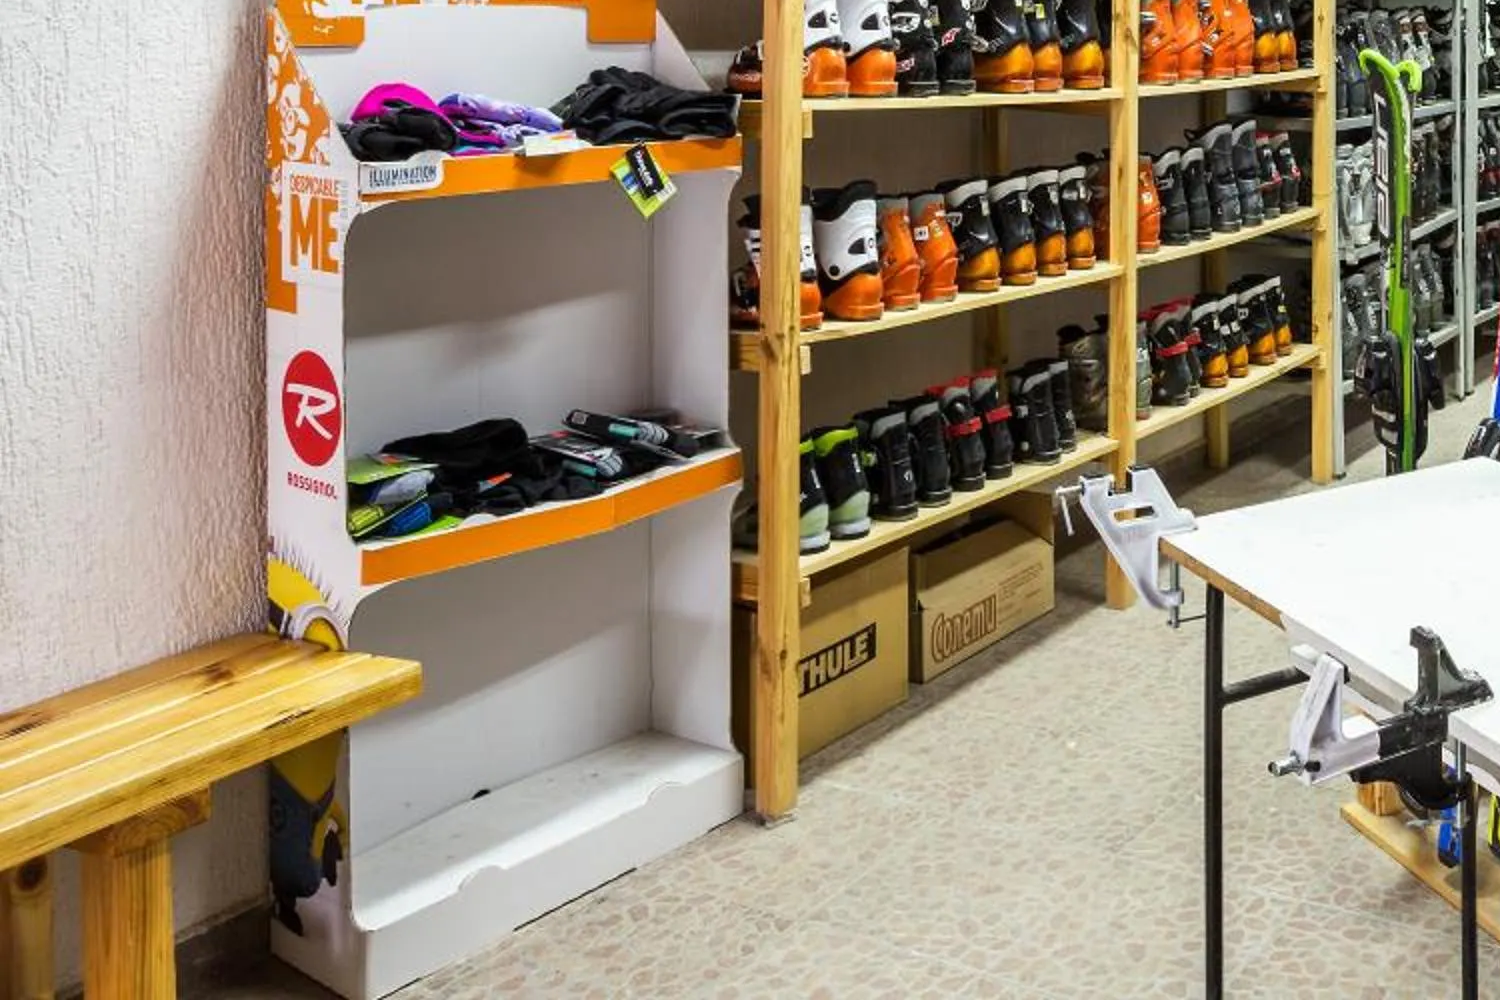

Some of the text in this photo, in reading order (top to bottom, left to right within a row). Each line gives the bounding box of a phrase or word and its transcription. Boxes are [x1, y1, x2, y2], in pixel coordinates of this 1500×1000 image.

[290, 194, 339, 273] ME
[287, 383, 337, 441] R
[287, 471, 338, 500] ROSSIGNOL
